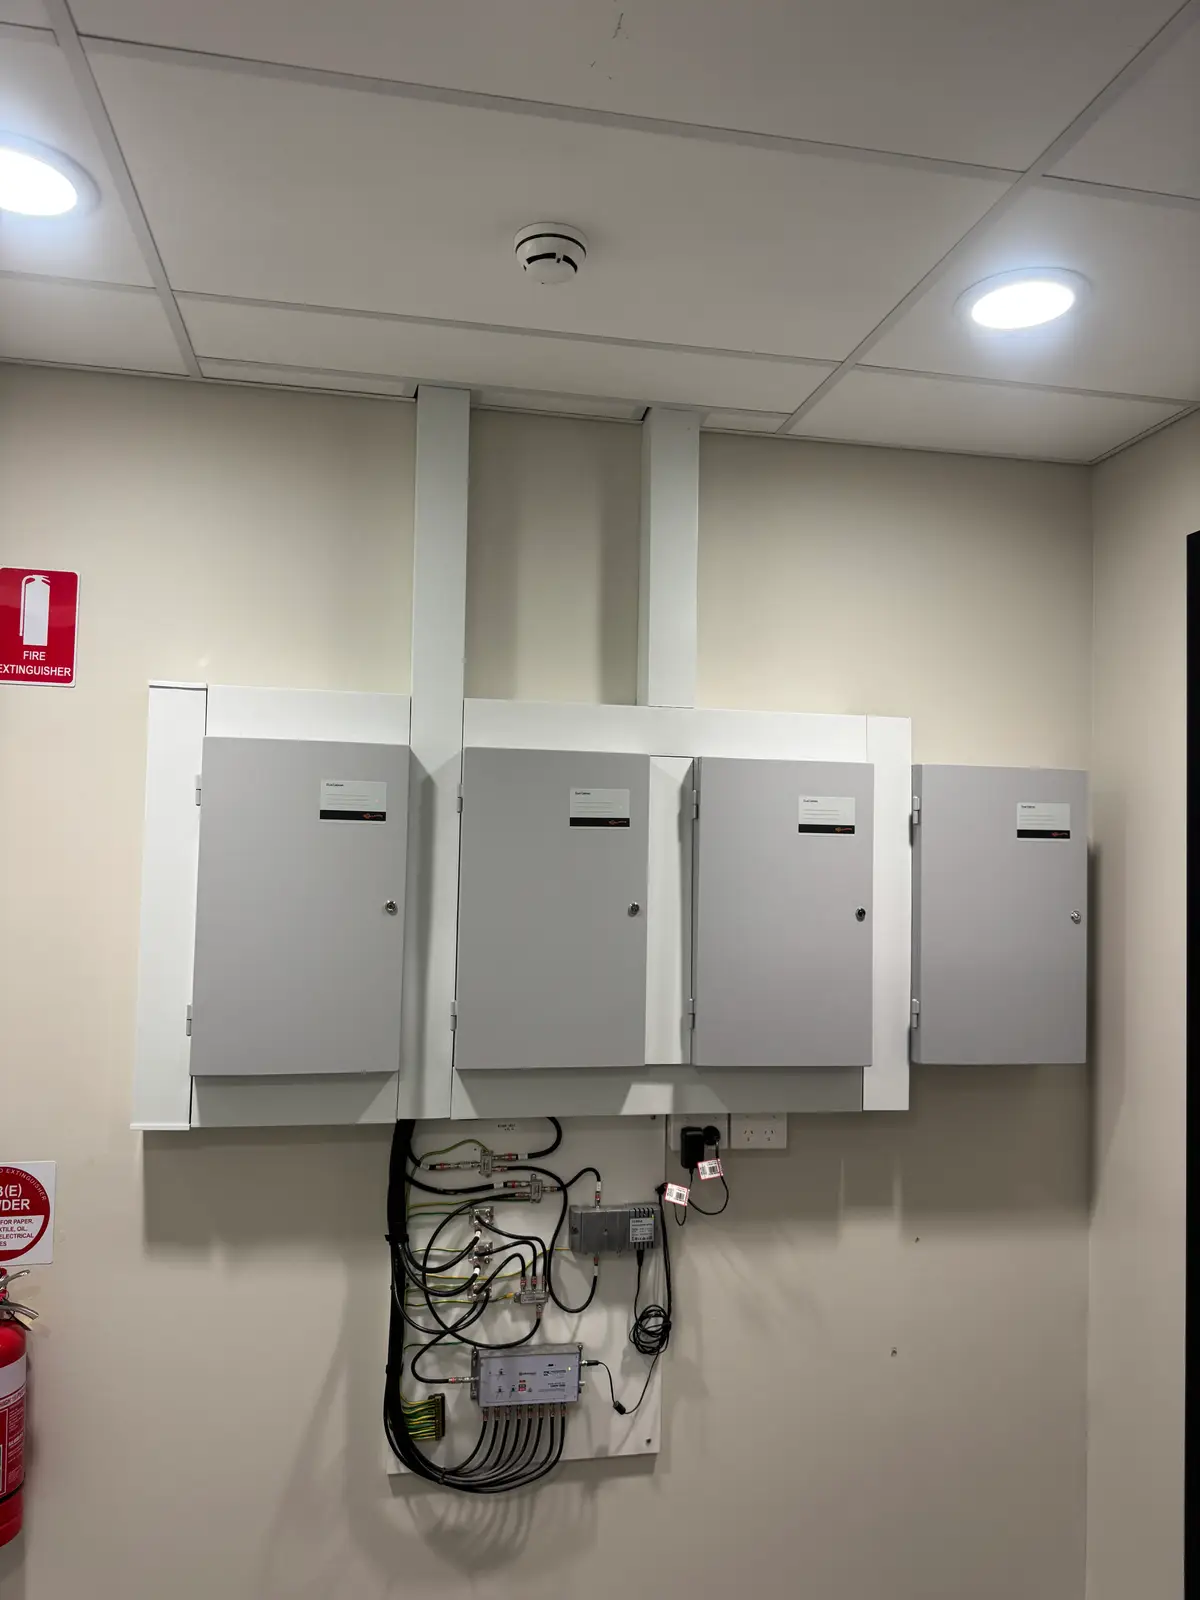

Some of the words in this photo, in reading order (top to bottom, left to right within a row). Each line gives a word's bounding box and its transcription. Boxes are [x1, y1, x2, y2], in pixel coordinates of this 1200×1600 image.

[23, 650, 46, 661] FIRE
[6, 1168, 47, 1201] EXTINGUISHER
[0, 1199, 30, 1211] DER
